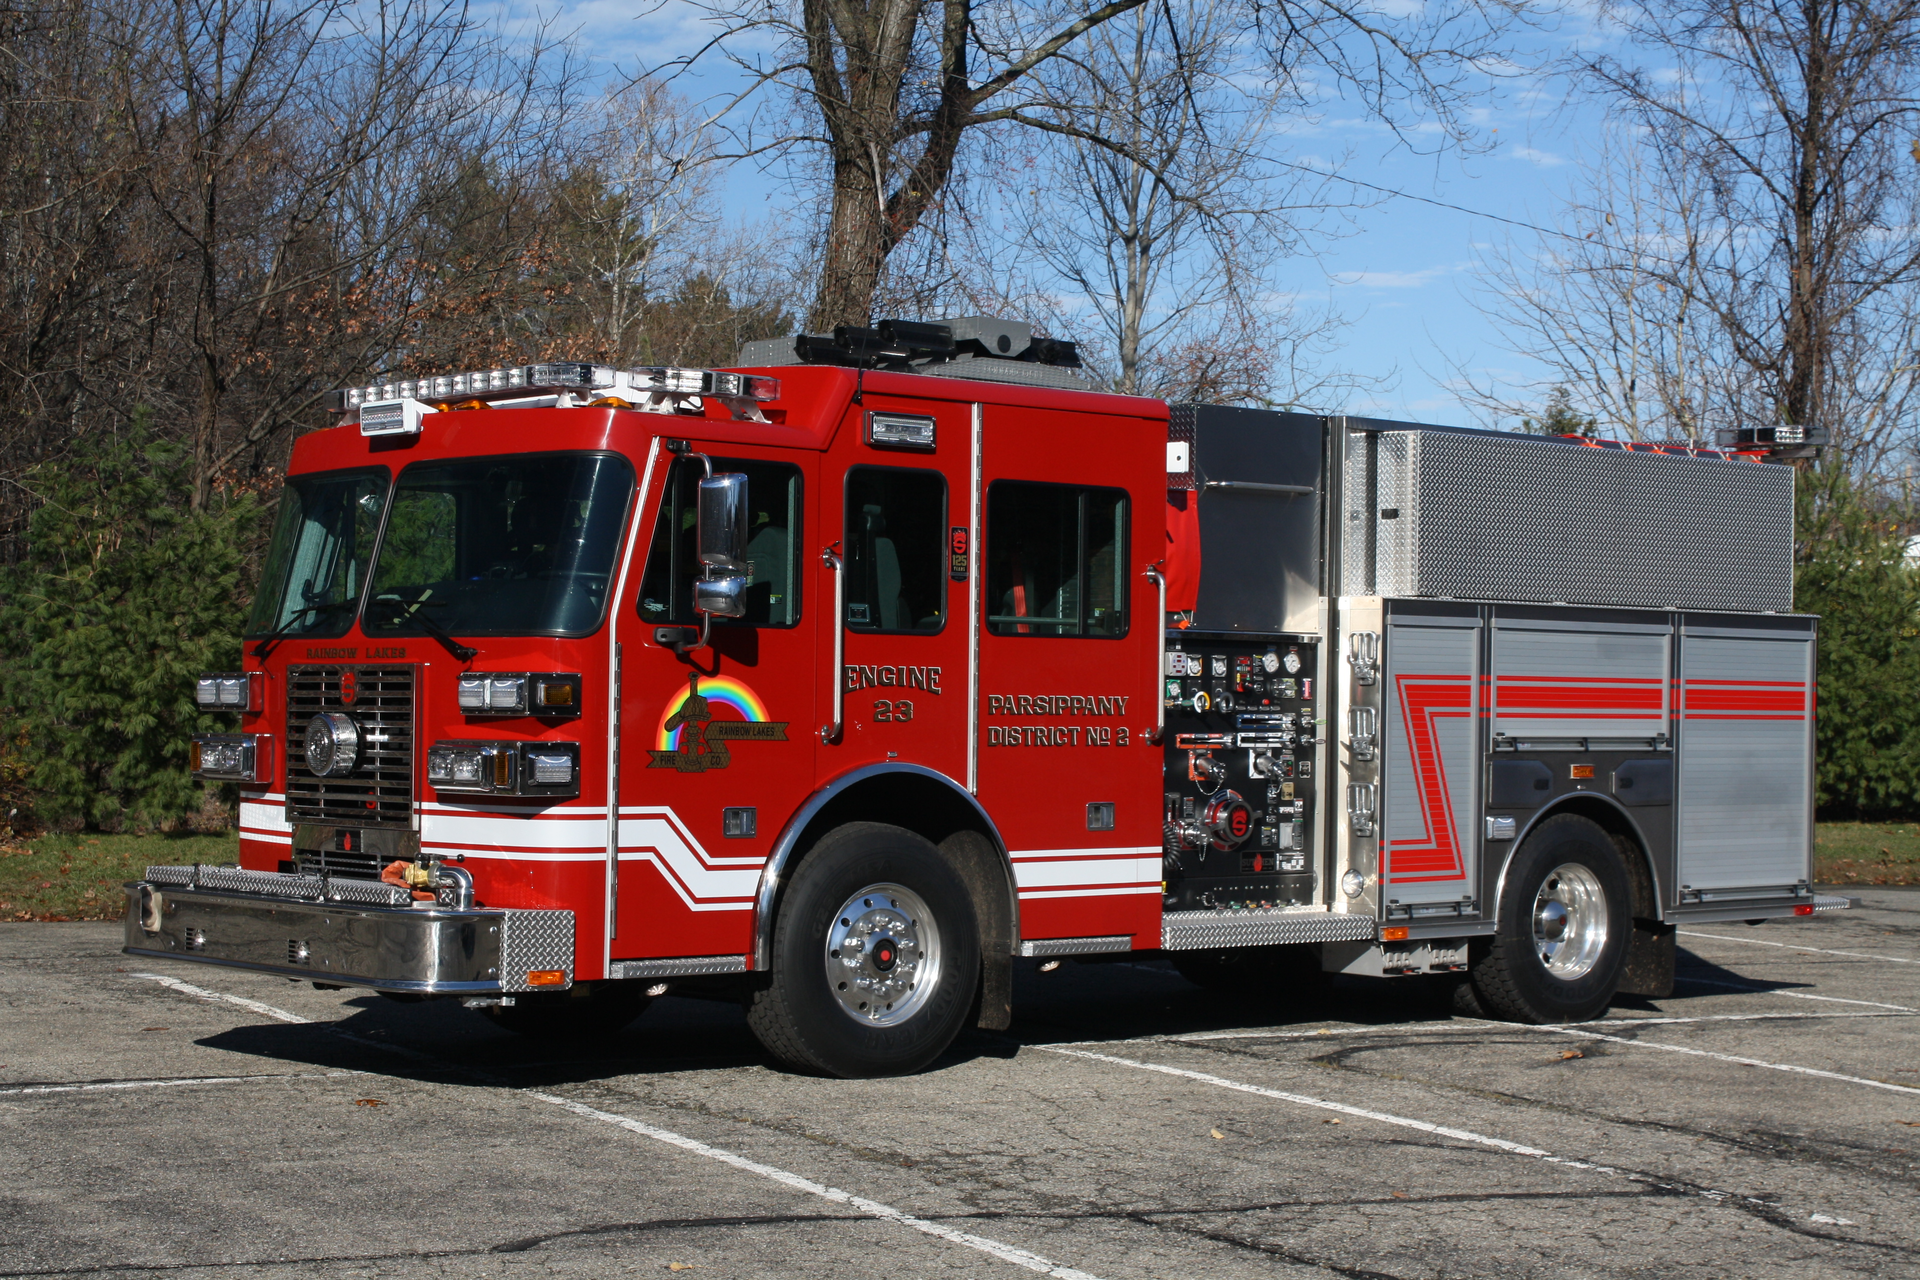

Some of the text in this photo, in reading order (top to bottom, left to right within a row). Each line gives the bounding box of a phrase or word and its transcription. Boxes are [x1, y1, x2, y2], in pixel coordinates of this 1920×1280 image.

[952, 555, 967, 566] 125
[306, 647, 406, 659] RAINBOW LAKES
[844, 664, 942, 695] ENGINE
[988, 694, 1129, 715] PARSIPPANY
[873, 699, 914, 723] 23
[719, 726, 776, 736] RAINBOW LAKES
[987, 726, 1081, 747] DISTRICT
[1115, 726, 1130, 747] 2
[660, 755, 723, 766] FIRE CO.
[1242, 857, 1274, 867] SUTHEN
